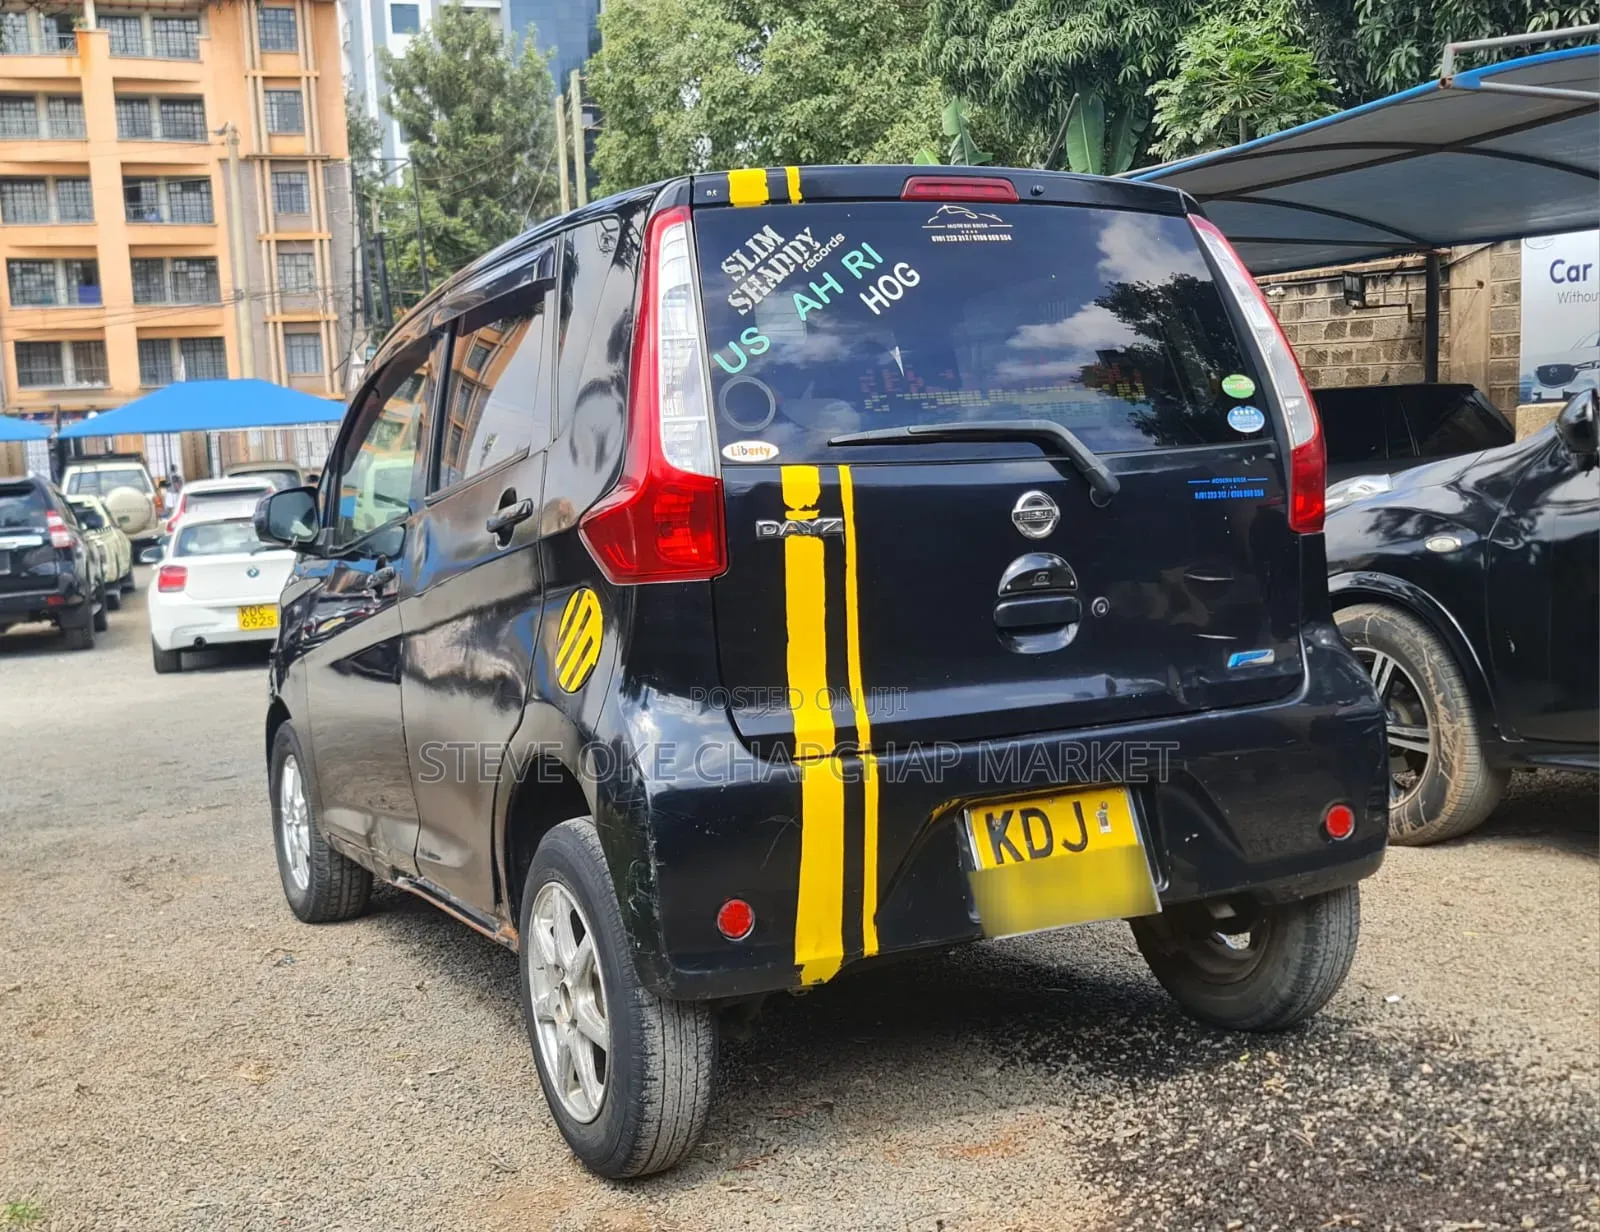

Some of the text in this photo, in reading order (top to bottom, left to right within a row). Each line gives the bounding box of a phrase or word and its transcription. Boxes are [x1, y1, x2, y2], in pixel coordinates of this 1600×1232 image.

[721, 225, 785, 282] SLIM
[728, 226, 821, 315] SHADDY
[802, 233, 845, 272] records
[1550, 259, 1593, 284] Car
[713, 242, 884, 374] US AH RI
[859, 262, 920, 315] HOG
[731, 445, 771, 459] Liberty
[756, 518, 844, 539] DAYZ
[985, 801, 1088, 865] KDJ
